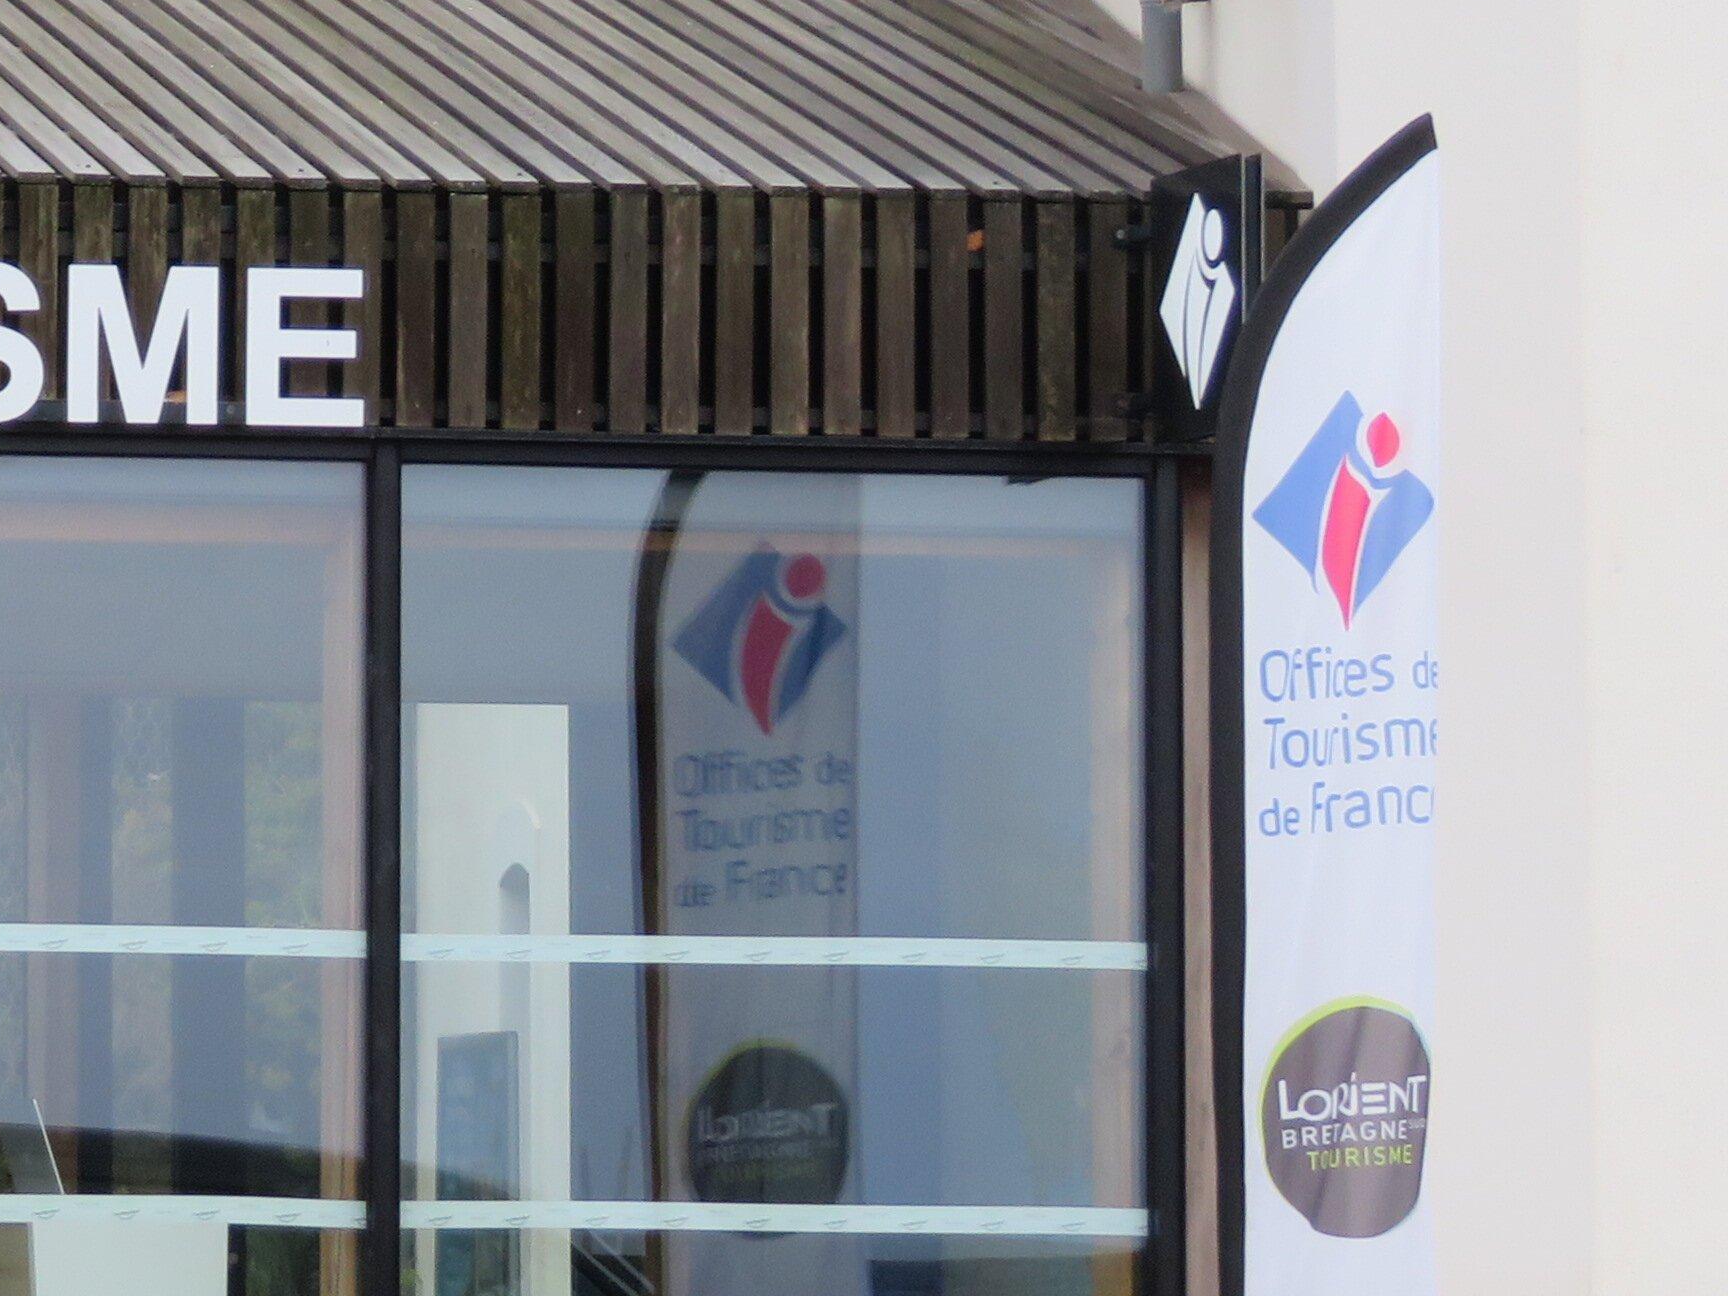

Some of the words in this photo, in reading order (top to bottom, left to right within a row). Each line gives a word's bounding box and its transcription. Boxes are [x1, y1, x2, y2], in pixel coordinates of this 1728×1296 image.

[1259, 646, 1395, 702] Offices
[1258, 797, 1301, 837] de
[1311, 781, 1435, 834] Franc
[1278, 1071, 1427, 1122] LORIENT
[1281, 1118, 1408, 1149] BRETAGNE
[1307, 1143, 1414, 1172] TOURISME
